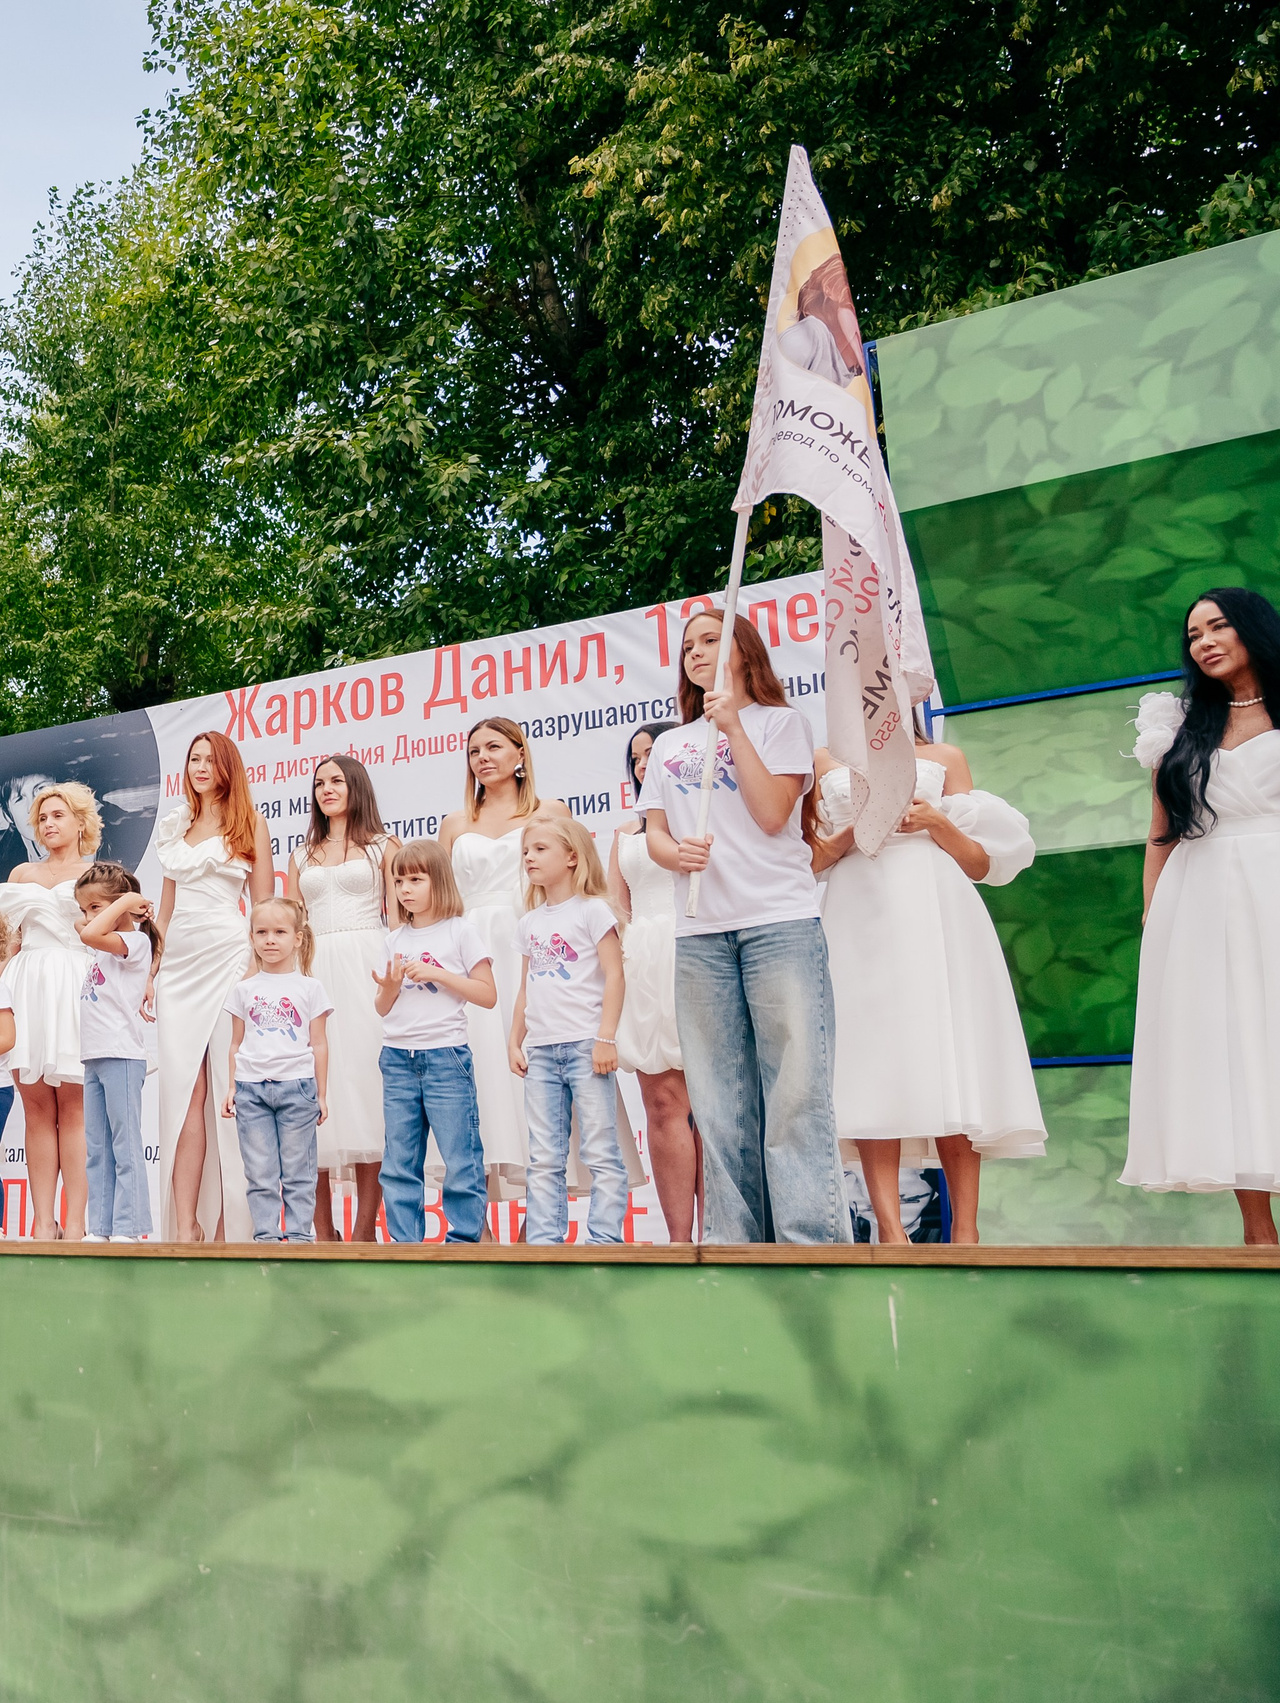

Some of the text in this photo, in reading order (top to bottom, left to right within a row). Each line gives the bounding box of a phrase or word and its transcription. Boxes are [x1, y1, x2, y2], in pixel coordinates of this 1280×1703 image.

[818, 445, 840, 463] по
[224, 671, 405, 745] Жарков
[423, 632, 625, 720] Данил,
[748, 590, 825, 648] ле
